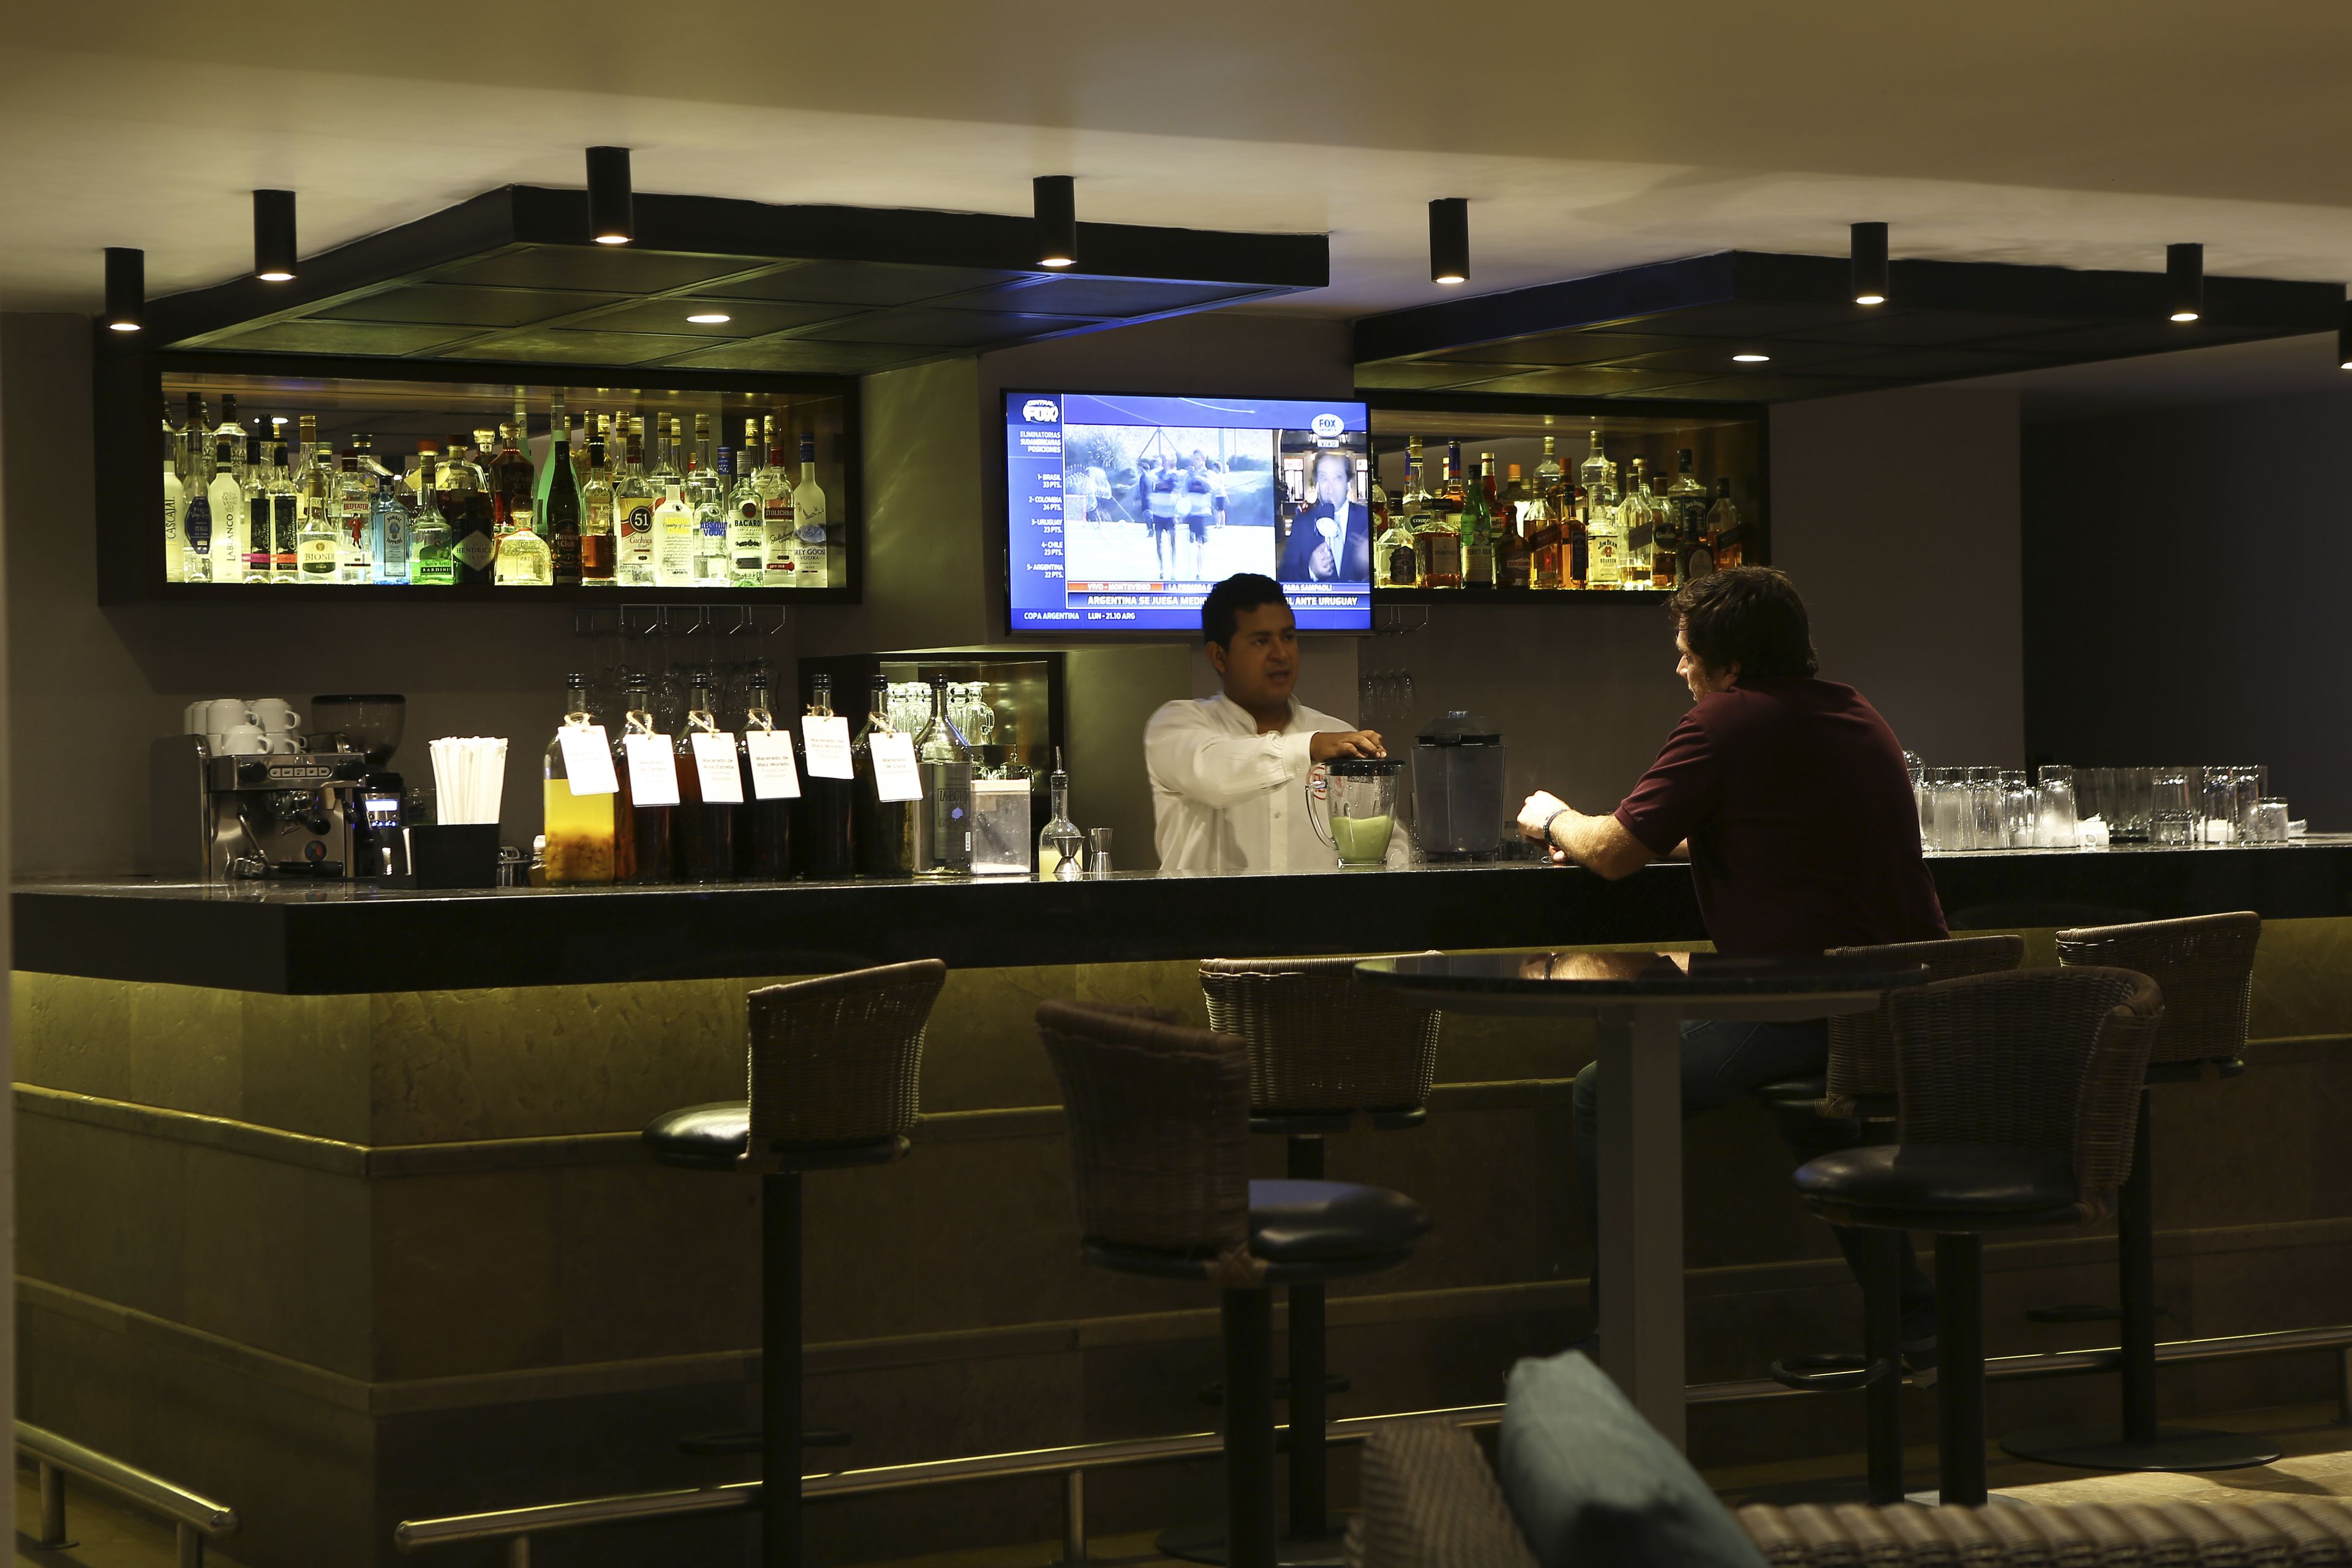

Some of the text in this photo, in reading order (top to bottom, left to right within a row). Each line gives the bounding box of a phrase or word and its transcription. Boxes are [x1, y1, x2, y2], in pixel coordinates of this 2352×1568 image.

[634, 513, 649, 527] 51
[227, 514, 236, 562] LABANCO
[1597, 539, 1618, 550] JIM BEAM
[1087, 596, 1137, 605] ARGENTINA
[1138, 596, 1150, 605] SE
[1152, 596, 1178, 605] JUEGA
[1295, 597, 1317, 606] ANTE
[1318, 597, 1358, 606] URUGUAY
